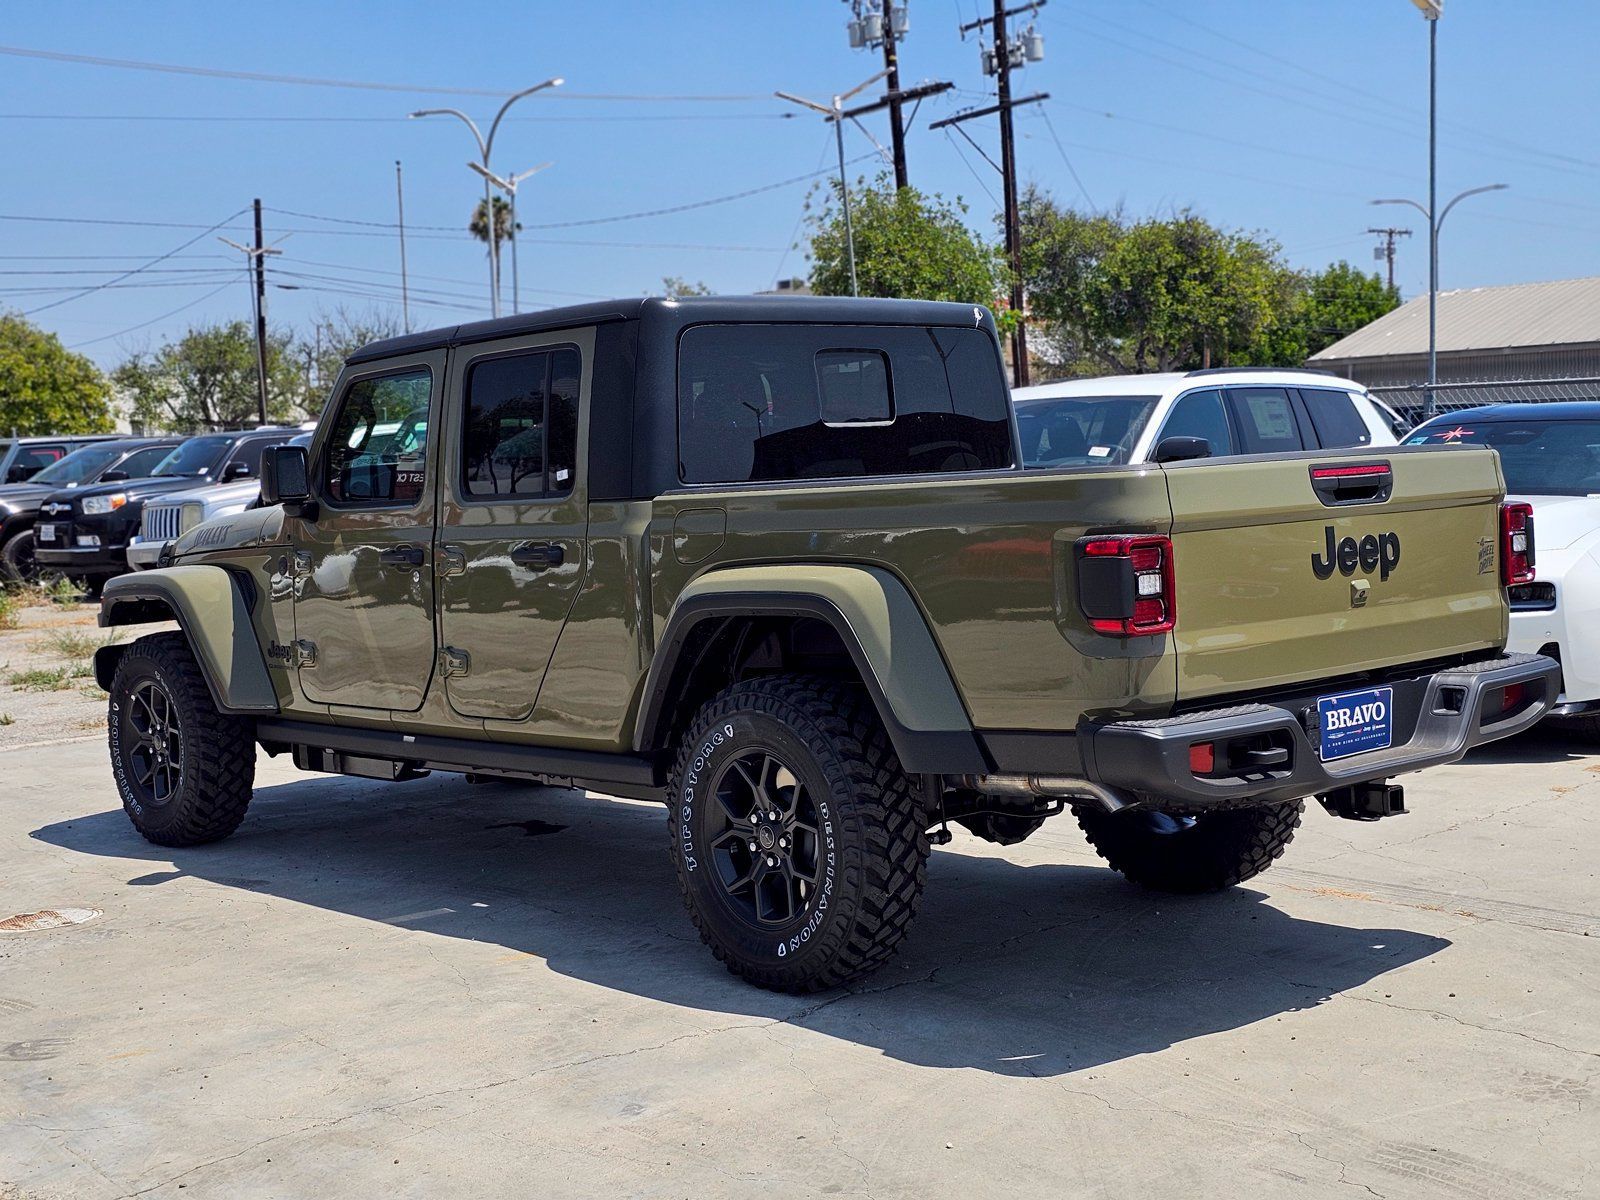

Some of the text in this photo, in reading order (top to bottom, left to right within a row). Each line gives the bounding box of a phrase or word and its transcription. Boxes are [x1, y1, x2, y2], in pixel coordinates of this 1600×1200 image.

[1311, 525, 1400, 582] Jeep
[1325, 701, 1386, 730] BRAVO
[789, 802, 835, 952] DESTINATION
